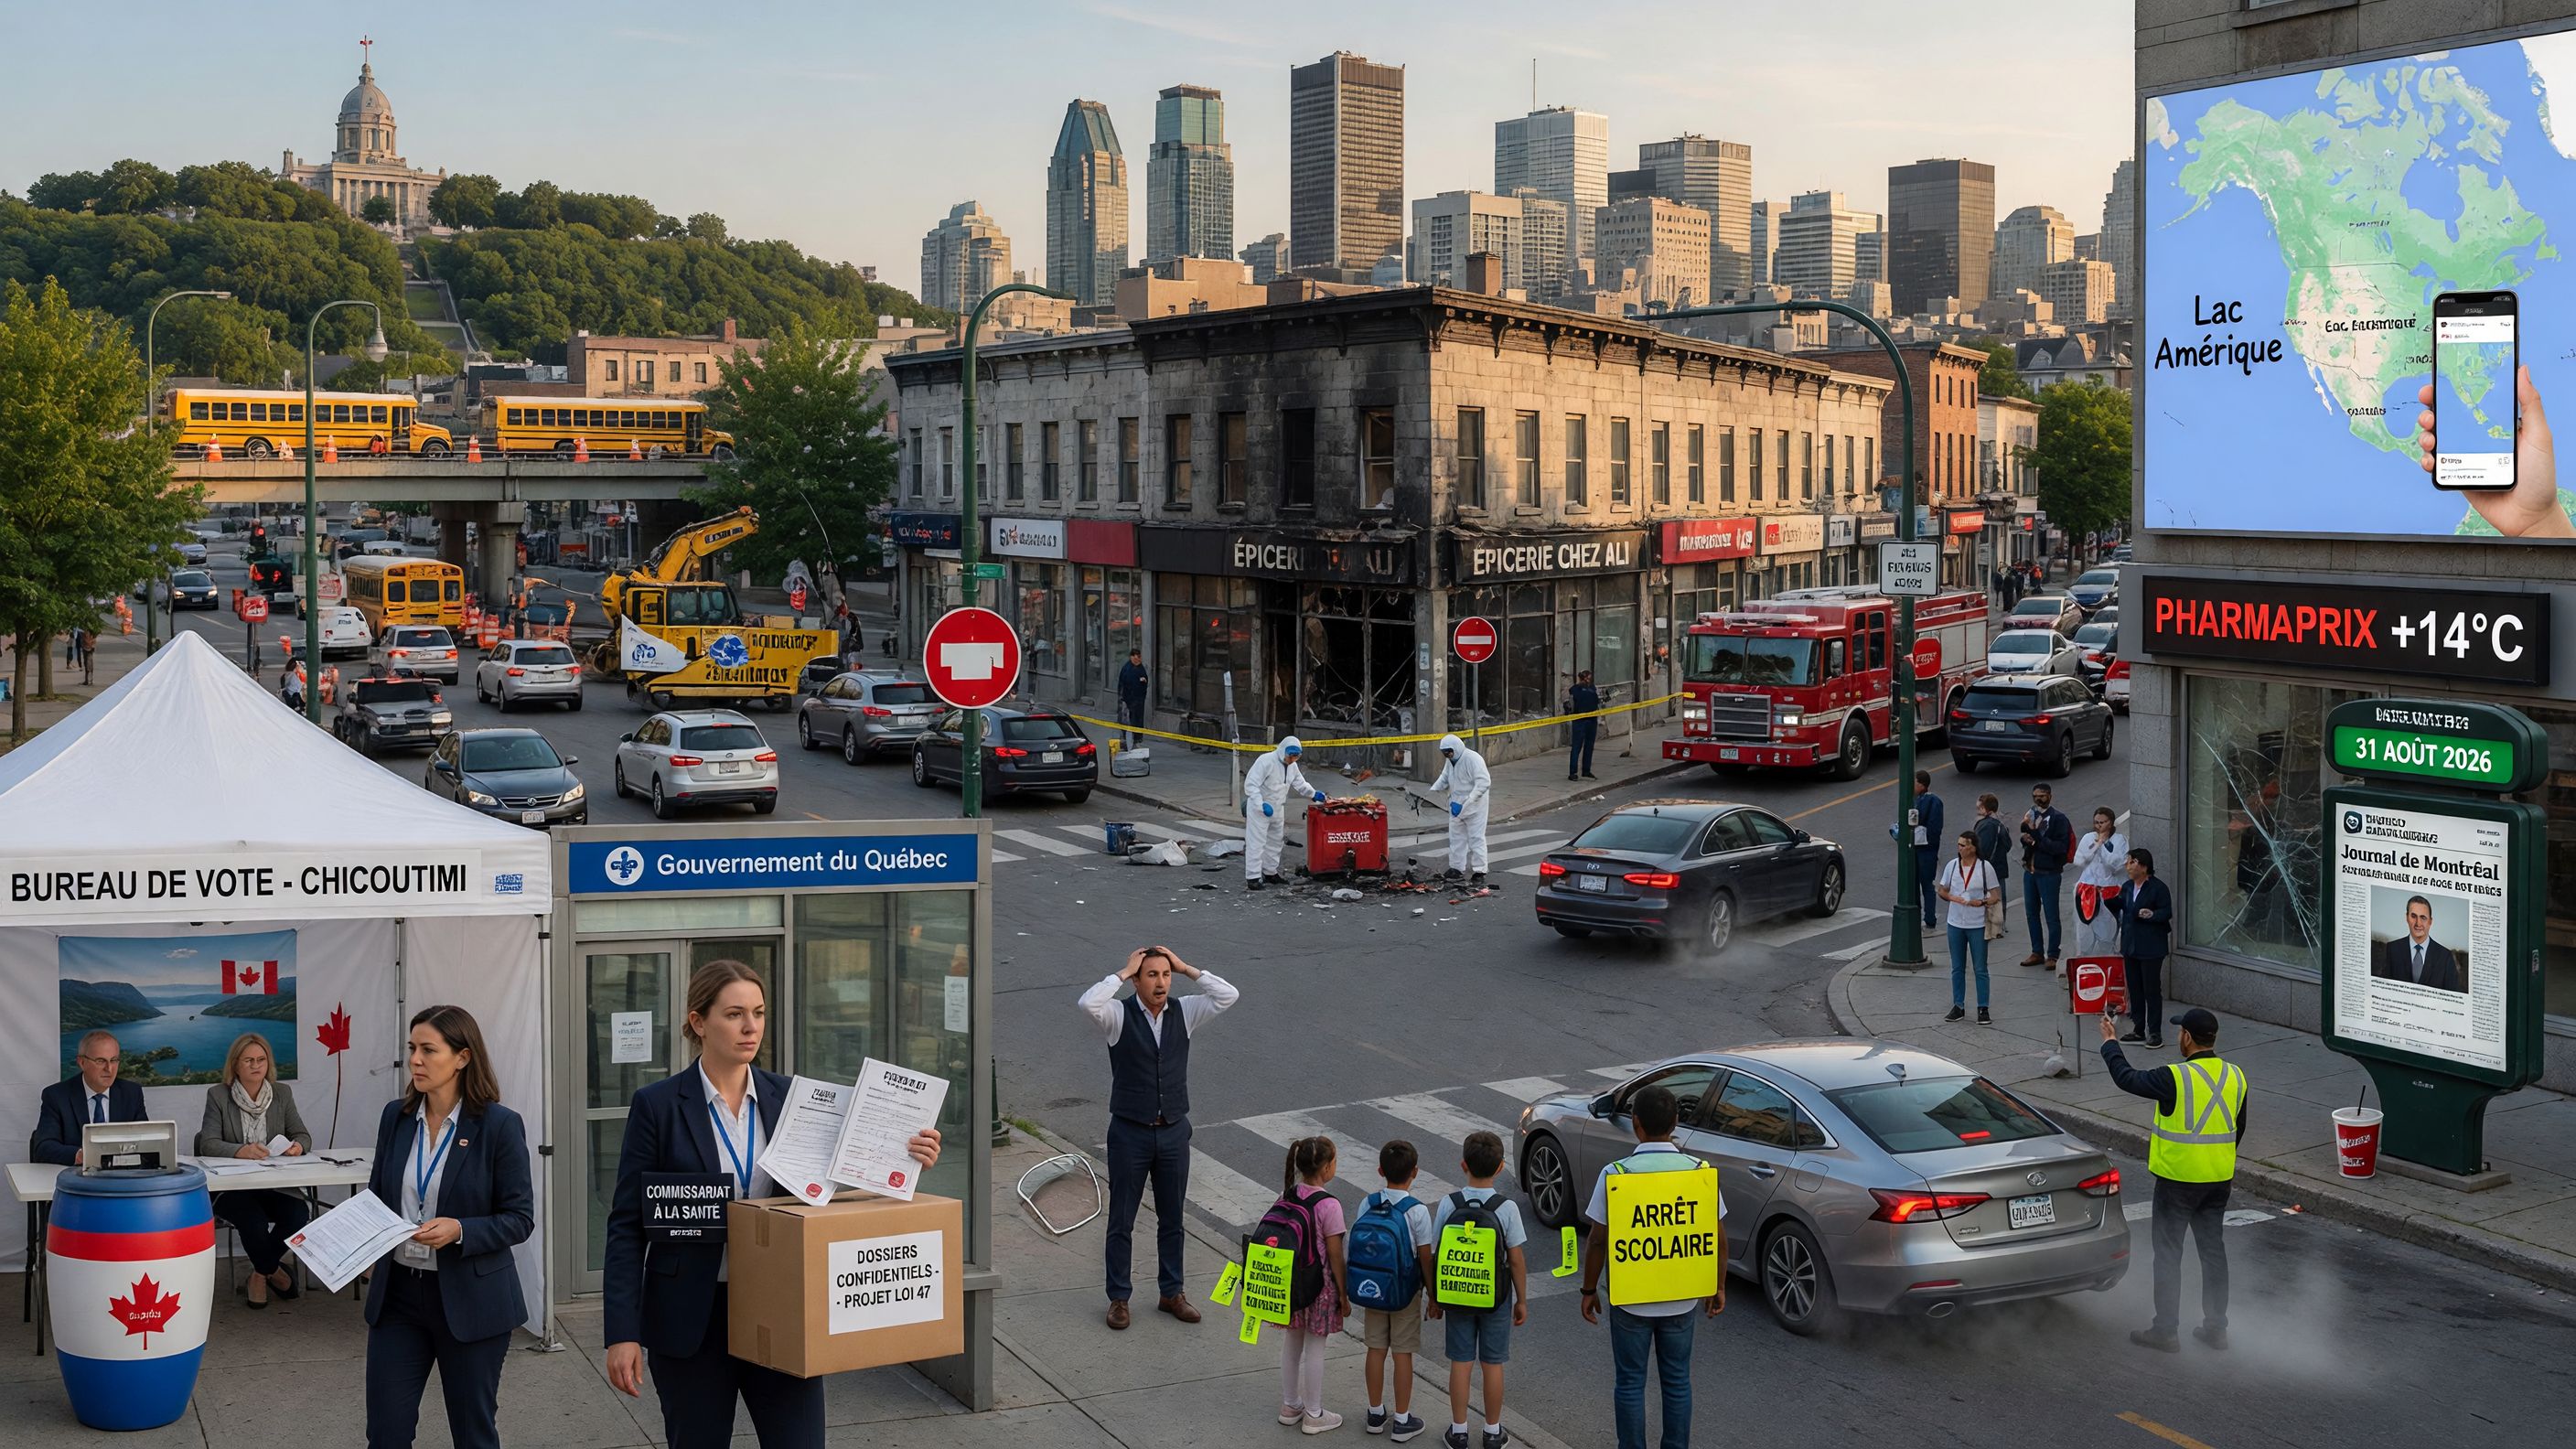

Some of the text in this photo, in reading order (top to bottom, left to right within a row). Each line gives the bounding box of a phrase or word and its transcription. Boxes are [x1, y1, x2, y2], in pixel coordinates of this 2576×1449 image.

[2195, 295, 2244, 326] Lac
[2154, 333, 2283, 376] Amérique
[1557, 542, 1601, 570] CHEZ
[1605, 541, 1630, 567] ALI
[2155, 596, 2525, 662] PHARMAPRIX +14°C
[2355, 736, 2492, 773] 31 AOÛT 2026
[657, 847, 948, 875] Gouvernement du Québec
[2399, 852, 2420, 869] de
[11, 870, 137, 902] BUREAU
[147, 869, 187, 898] DE
[195, 867, 274, 898] VOTE
[300, 864, 467, 896] CHICOUTIMI
[653, 1203, 721, 1219] À LA SANTÉ
[1631, 1196, 1698, 1229] ARRÊT
[857, 1244, 918, 1264] DOSSIERS
[1615, 1232, 1713, 1262] SCOLAIRE
[836, 1263, 932, 1288] CONFIDENTIELS
[844, 1289, 892, 1309] PROJET
[895, 1286, 914, 1302] LOI
[917, 1284, 931, 1299] 47
